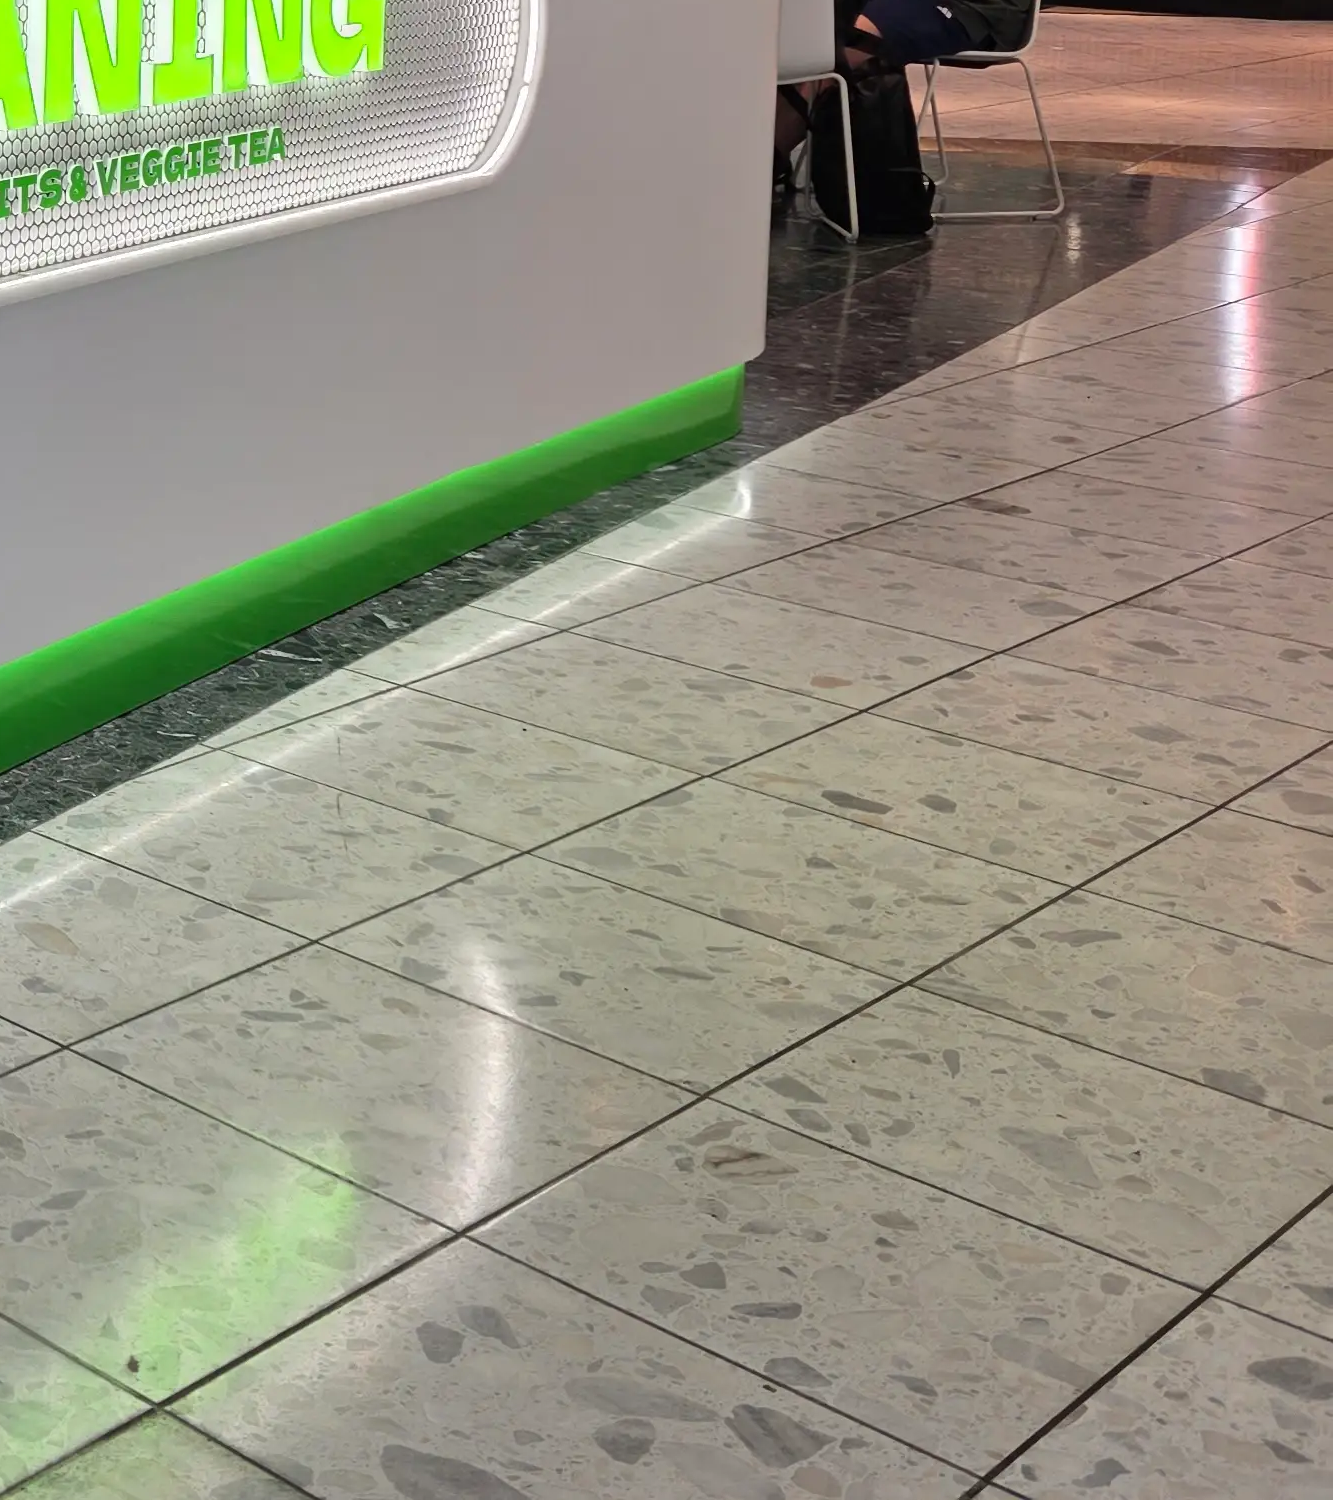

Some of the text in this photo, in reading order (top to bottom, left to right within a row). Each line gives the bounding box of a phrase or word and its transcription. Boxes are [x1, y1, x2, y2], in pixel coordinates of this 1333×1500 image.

[68, 164, 89, 202] &
[94, 138, 222, 197] VEGGIE
[231, 126, 287, 170] TEA
